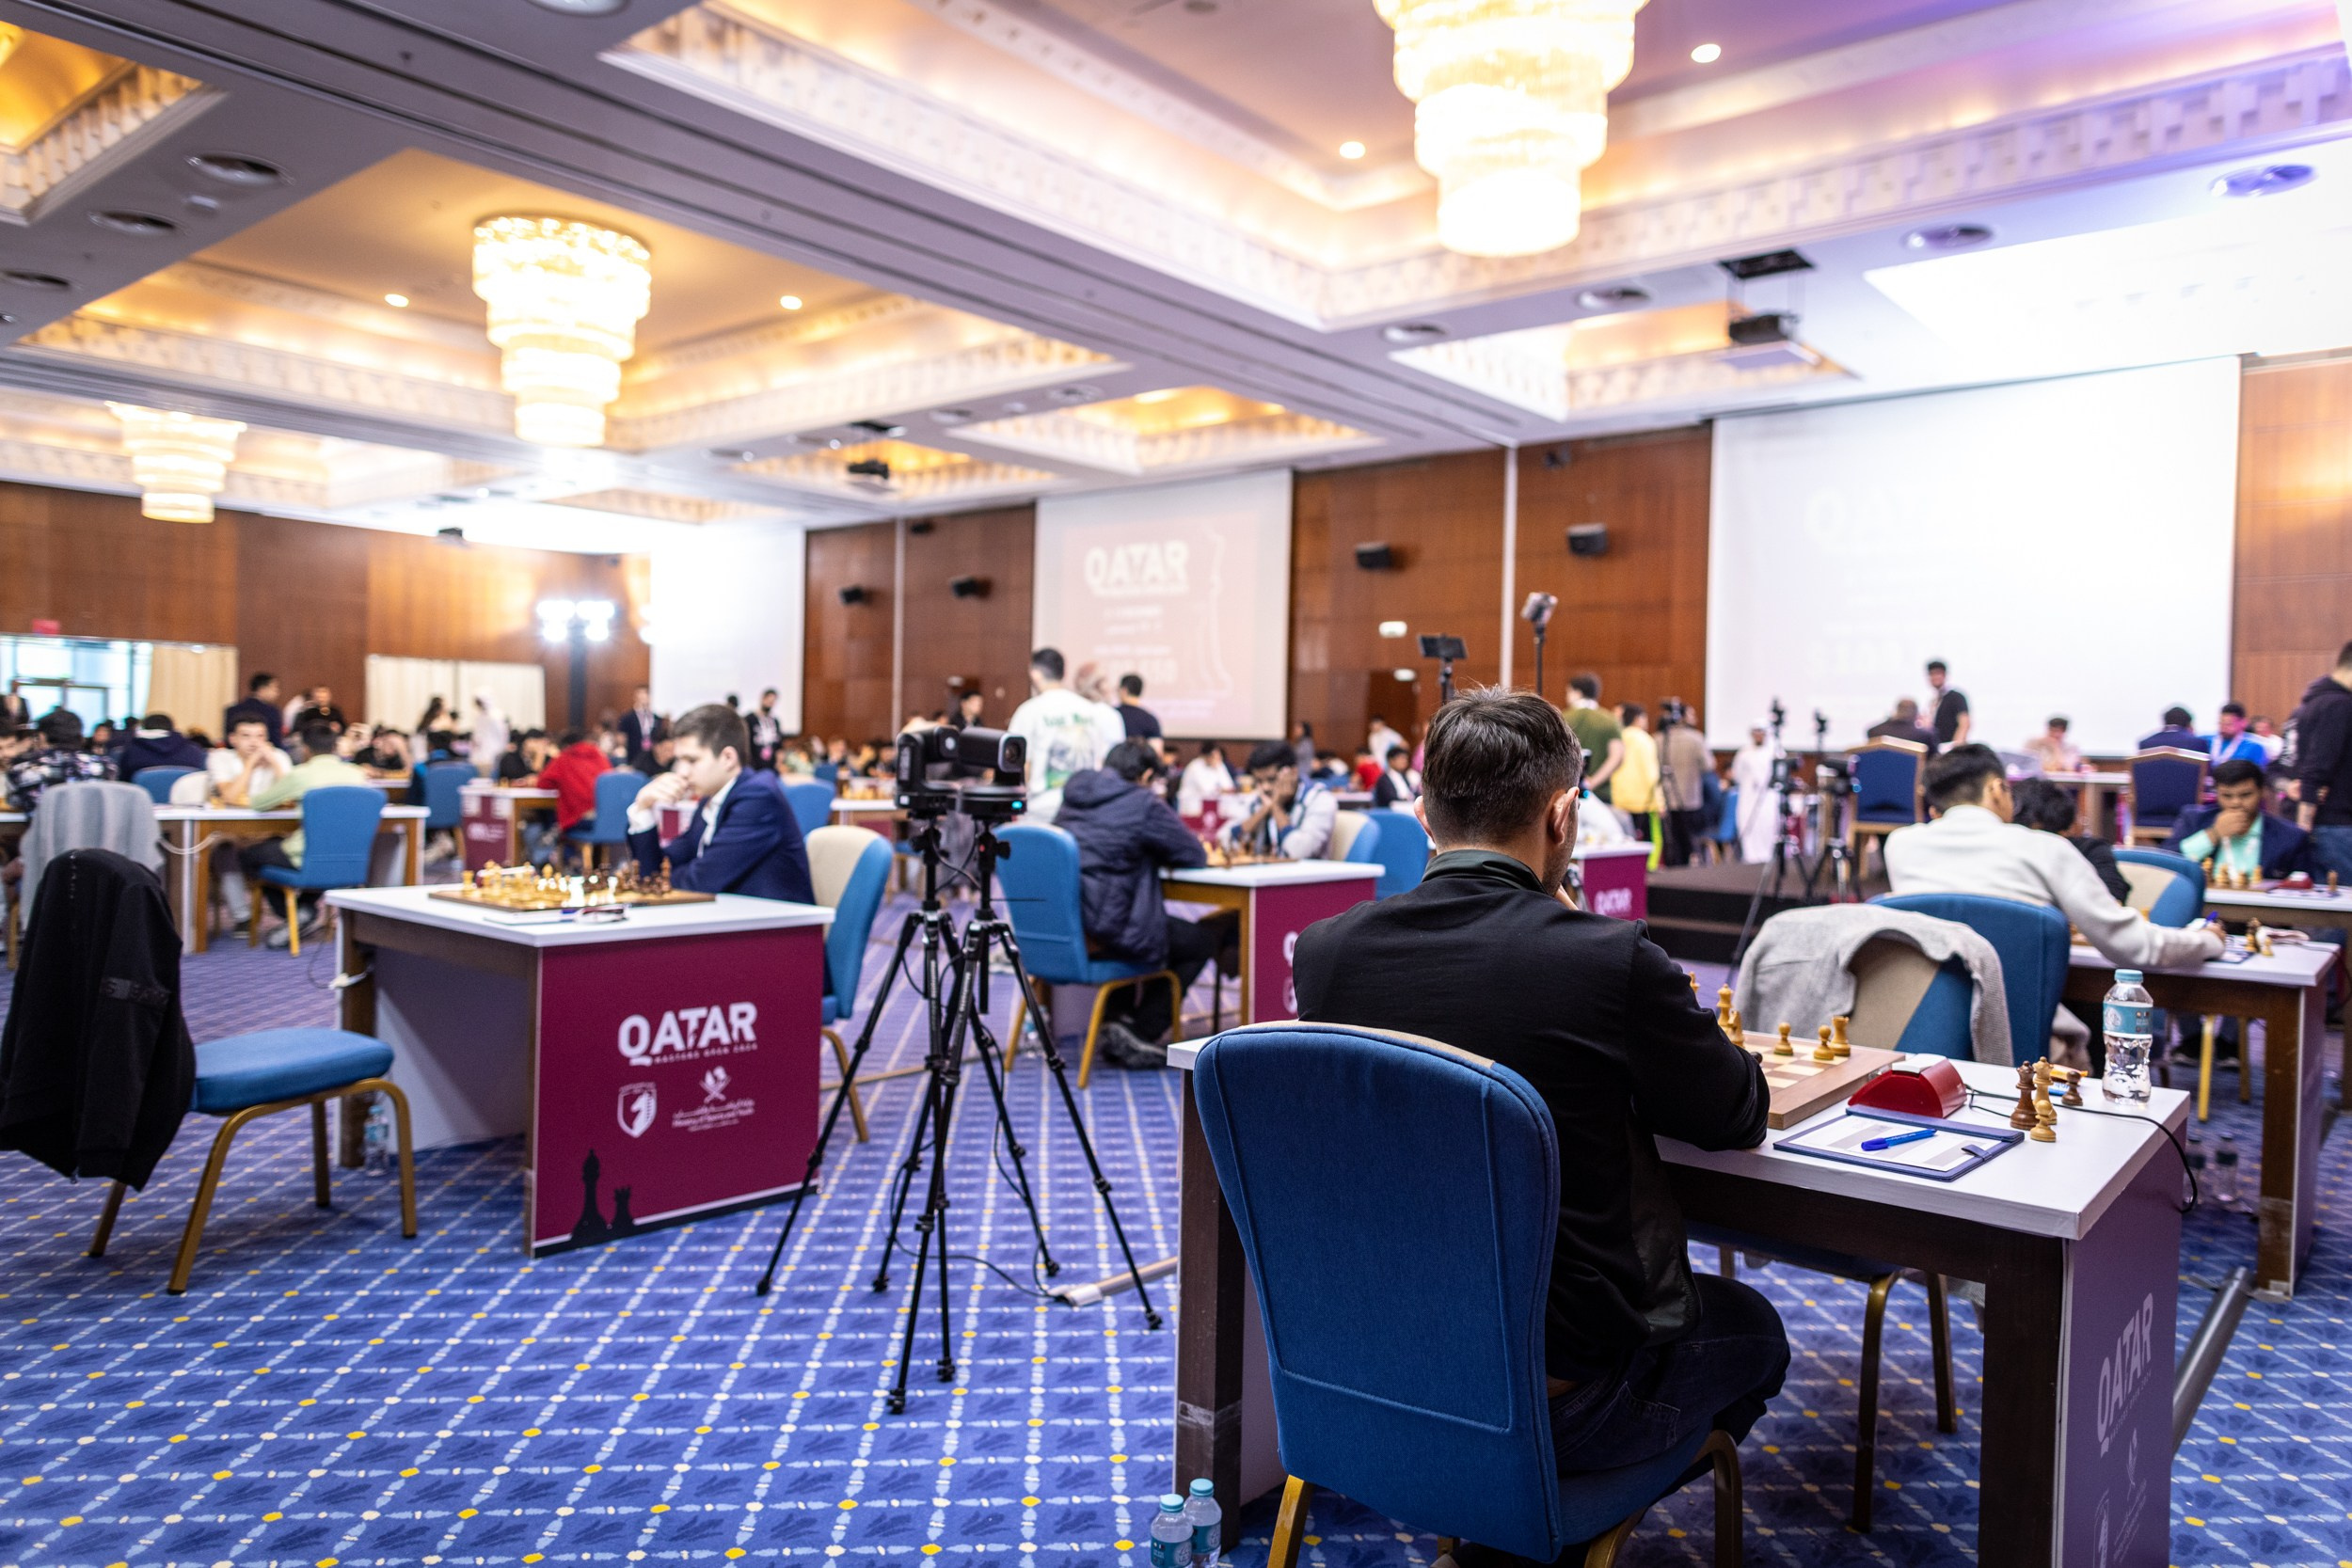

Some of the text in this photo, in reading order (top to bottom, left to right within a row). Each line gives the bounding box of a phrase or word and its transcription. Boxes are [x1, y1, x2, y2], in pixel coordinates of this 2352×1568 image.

[1087, 540, 1188, 595] QATAR
[617, 1001, 757, 1067] QATAR
[2097, 1292, 2153, 1458] QATAR
